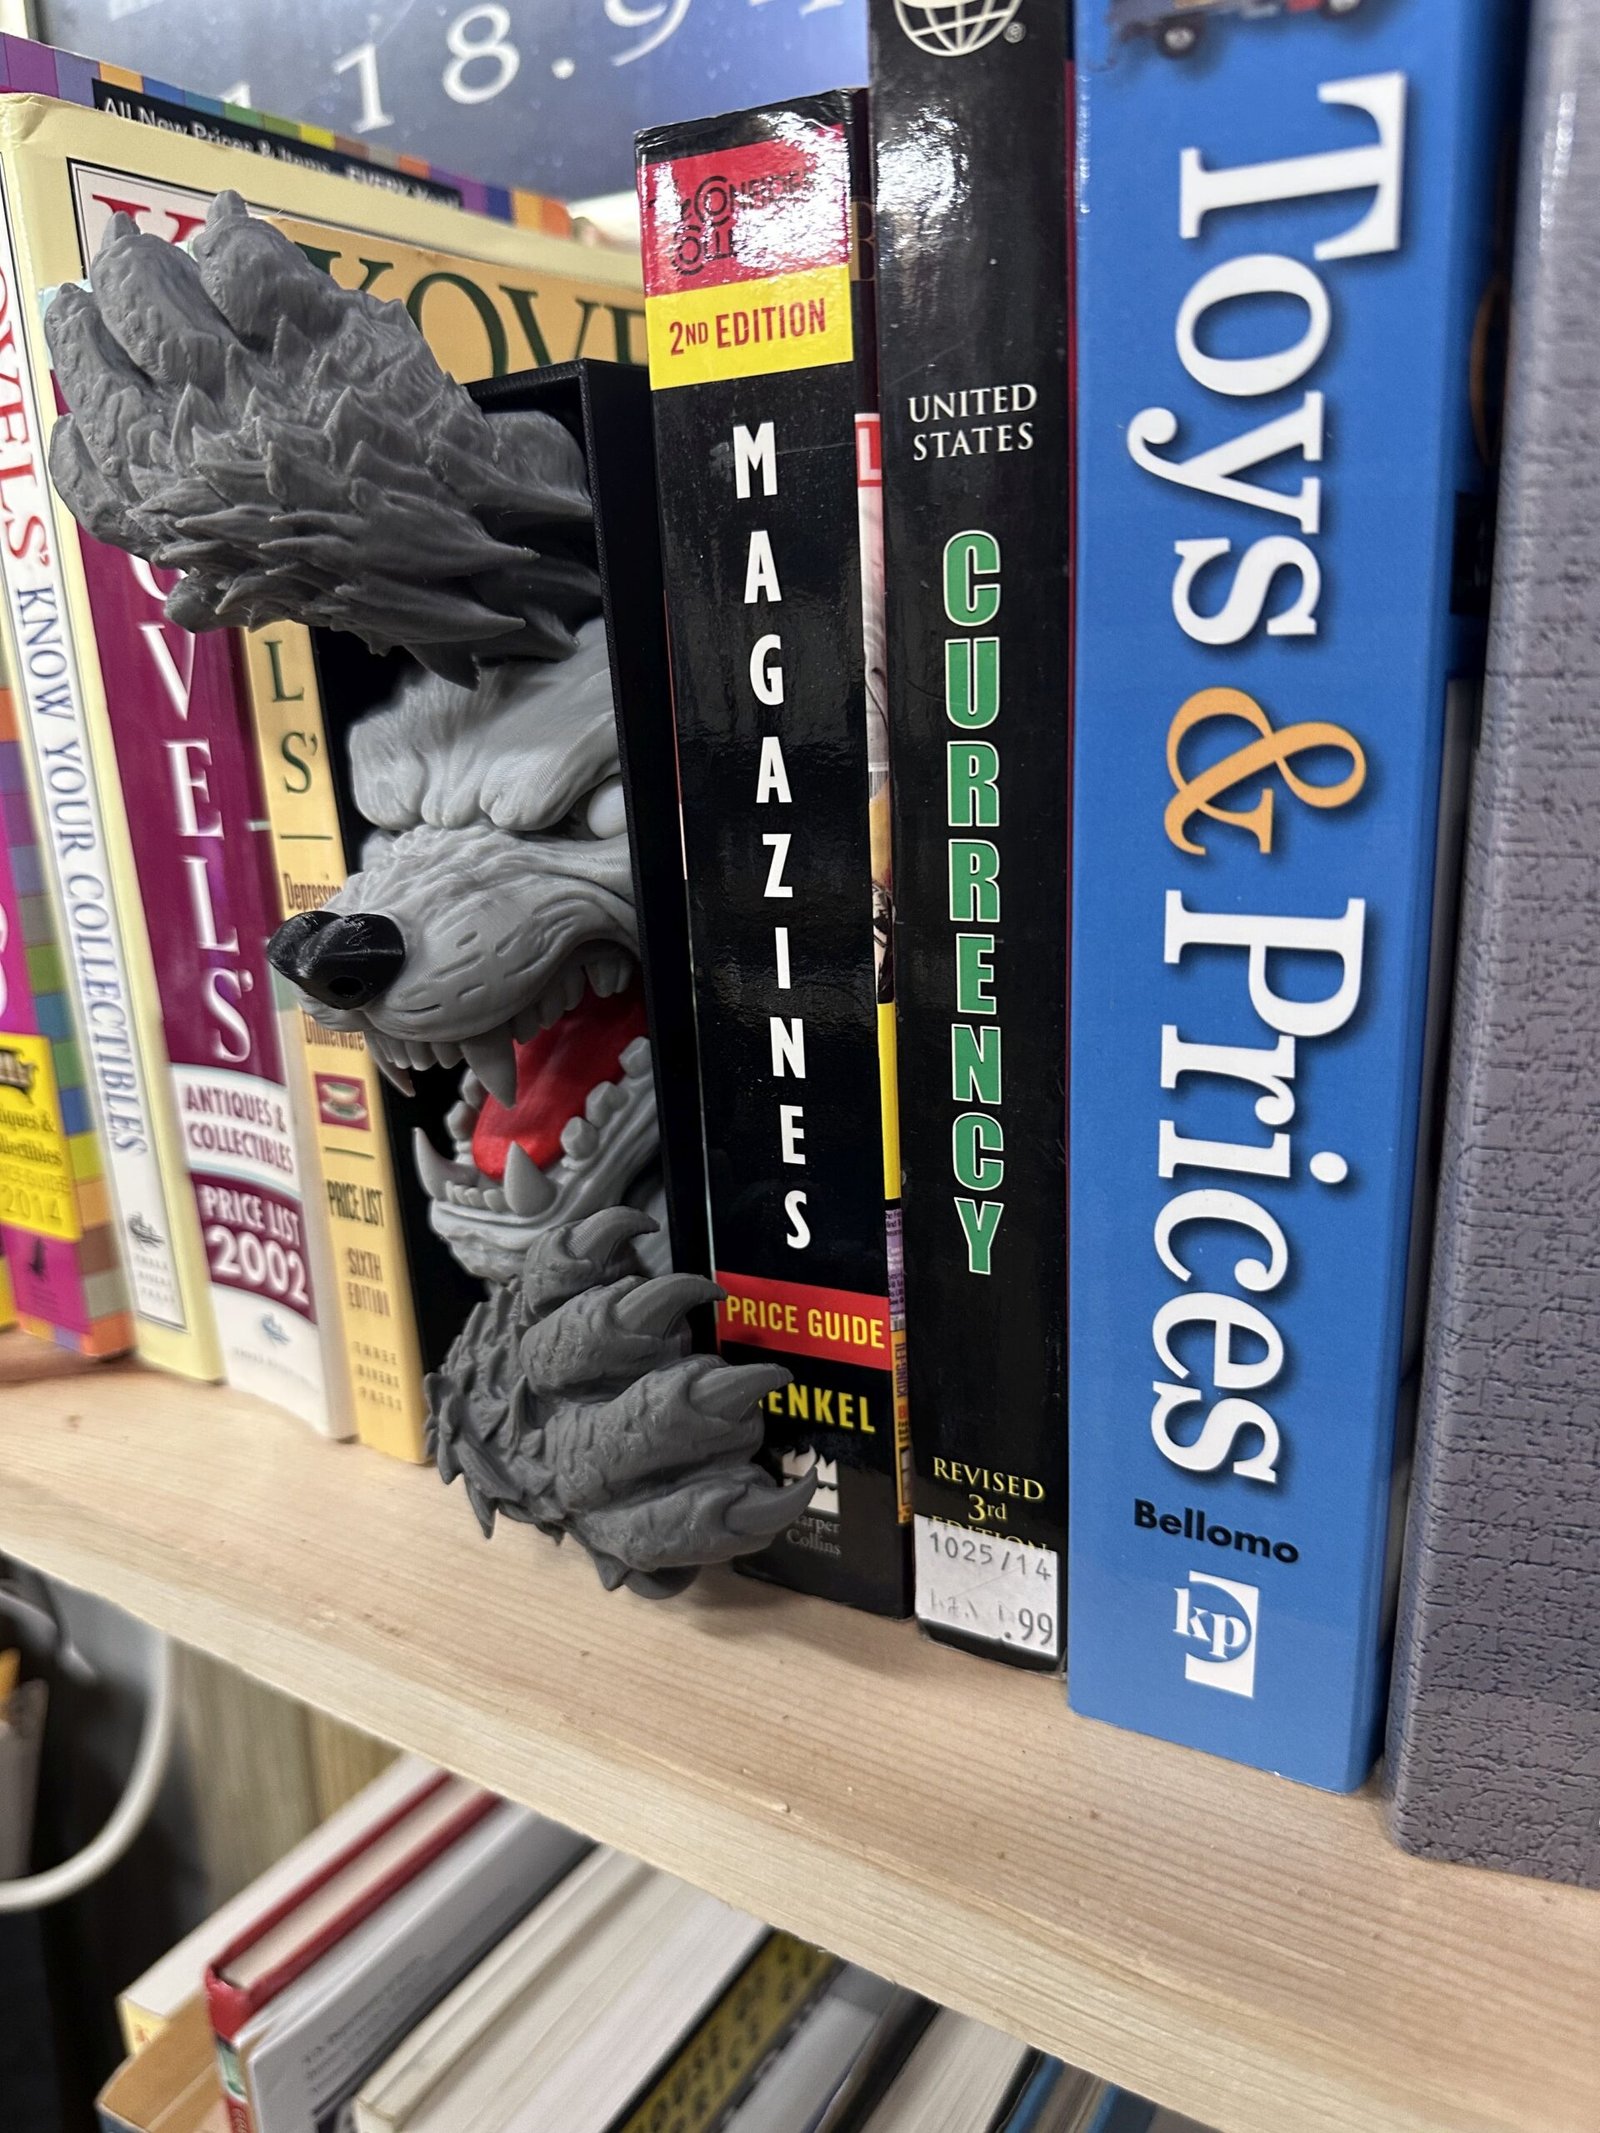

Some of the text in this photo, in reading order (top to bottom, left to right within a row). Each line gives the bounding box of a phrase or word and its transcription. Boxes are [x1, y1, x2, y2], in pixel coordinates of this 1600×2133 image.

[669, 297, 828, 357] 2ND EDITION
[908, 383, 1038, 423] UNITED
[913, 422, 1035, 462] STATES
[16, 583, 75, 722] KNOW
[43, 738, 97, 859] YOUR
[1126, 70, 1406, 1487] Toys & Prices
[732, 420, 812, 1250] MAGAZINES
[943, 529, 1005, 1276] CURRENCY
[65, 873, 149, 1156] COLLECTIBLES
[186, 1083, 287, 1133] ANTIQUES &
[188, 1122, 294, 1174] COLLECTIBLES
[199, 1183, 300, 1248] PRICE LIST
[326, 1179, 385, 1228] PRICE LIST
[206, 1224, 310, 1306] 2002
[347, 1246, 383, 1283] SIXTH
[726, 1294, 885, 1350] PRICE GUIDE
[758, 1382, 876, 1433] ENKEL
[932, 1456, 1045, 1500] REVISED
[797, 1515, 841, 1535] arper
[968, 1494, 1007, 1521] 3rd
[1134, 1498, 1299, 1564] Bellomo
[786, 1528, 841, 1556] Collins
[1172, 1587, 1247, 1659] kp
